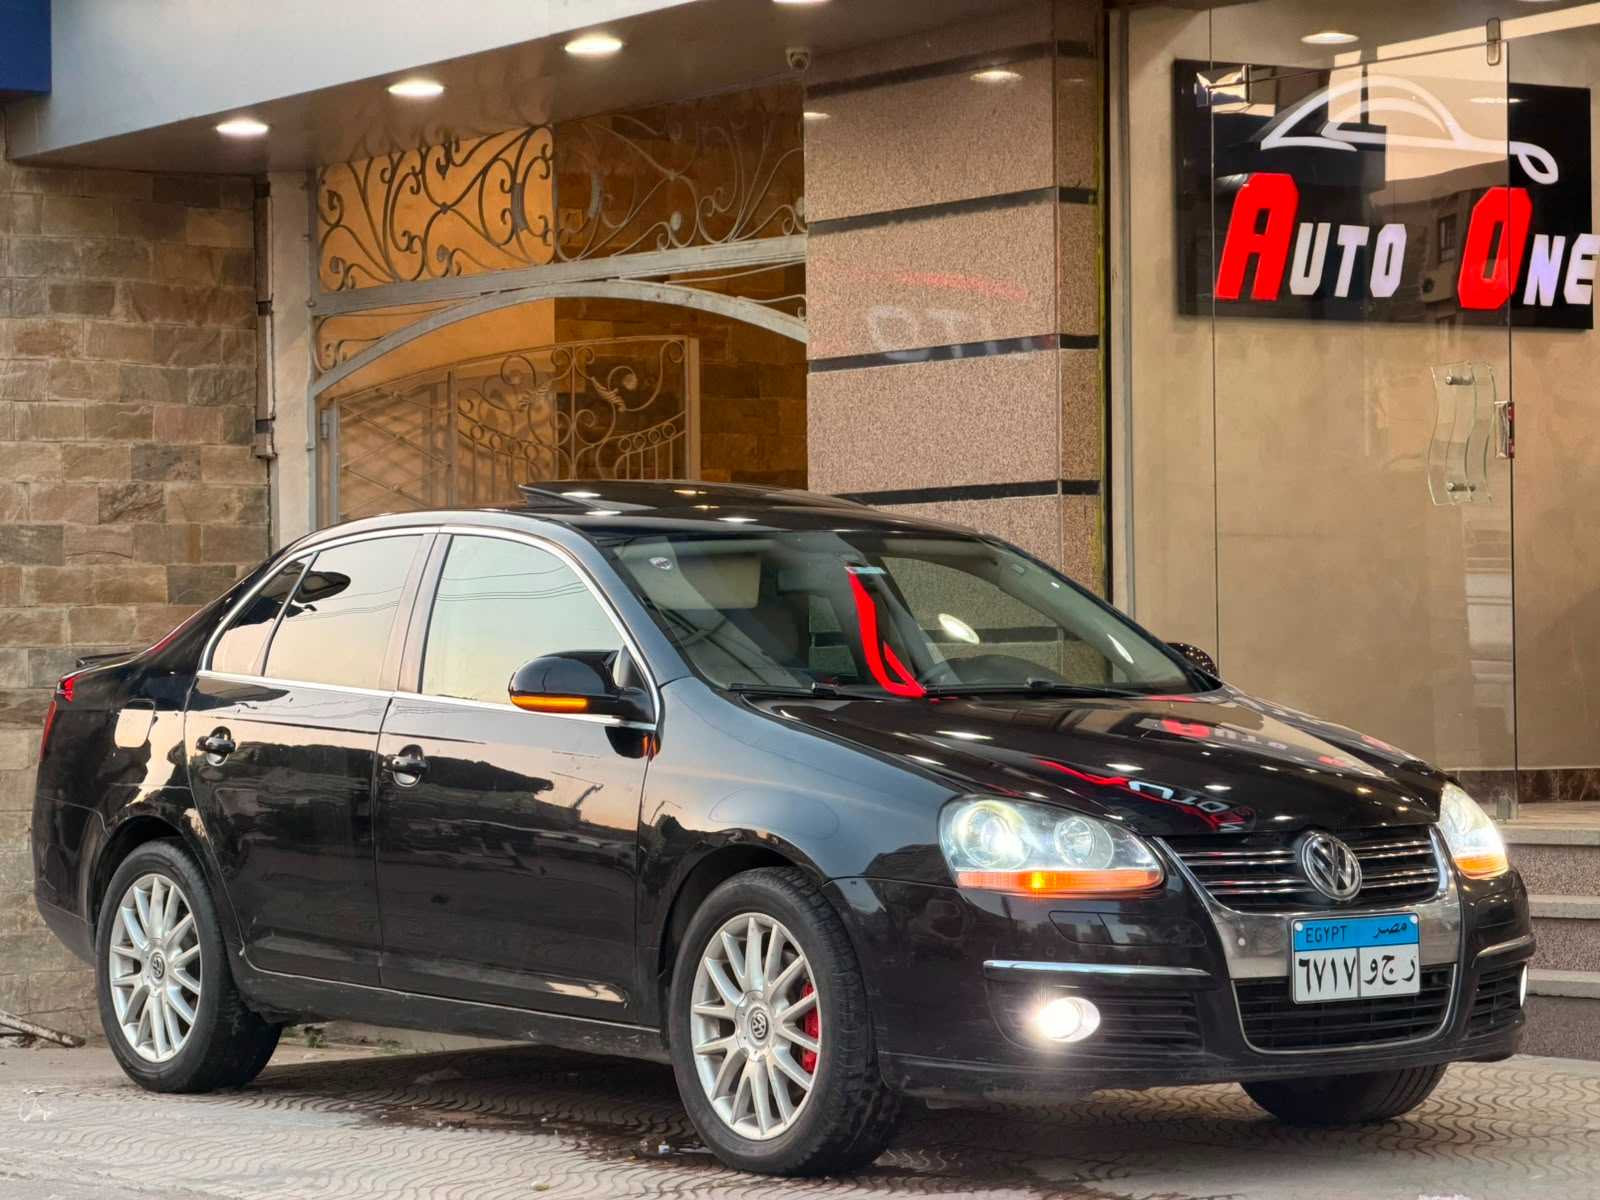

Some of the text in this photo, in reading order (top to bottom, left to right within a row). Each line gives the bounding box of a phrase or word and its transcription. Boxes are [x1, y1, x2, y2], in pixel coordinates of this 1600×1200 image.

[1216, 173, 1407, 300] AUTO
[1305, 925, 1348, 944] EGYPT
[1373, 922, 1408, 939] مصر
